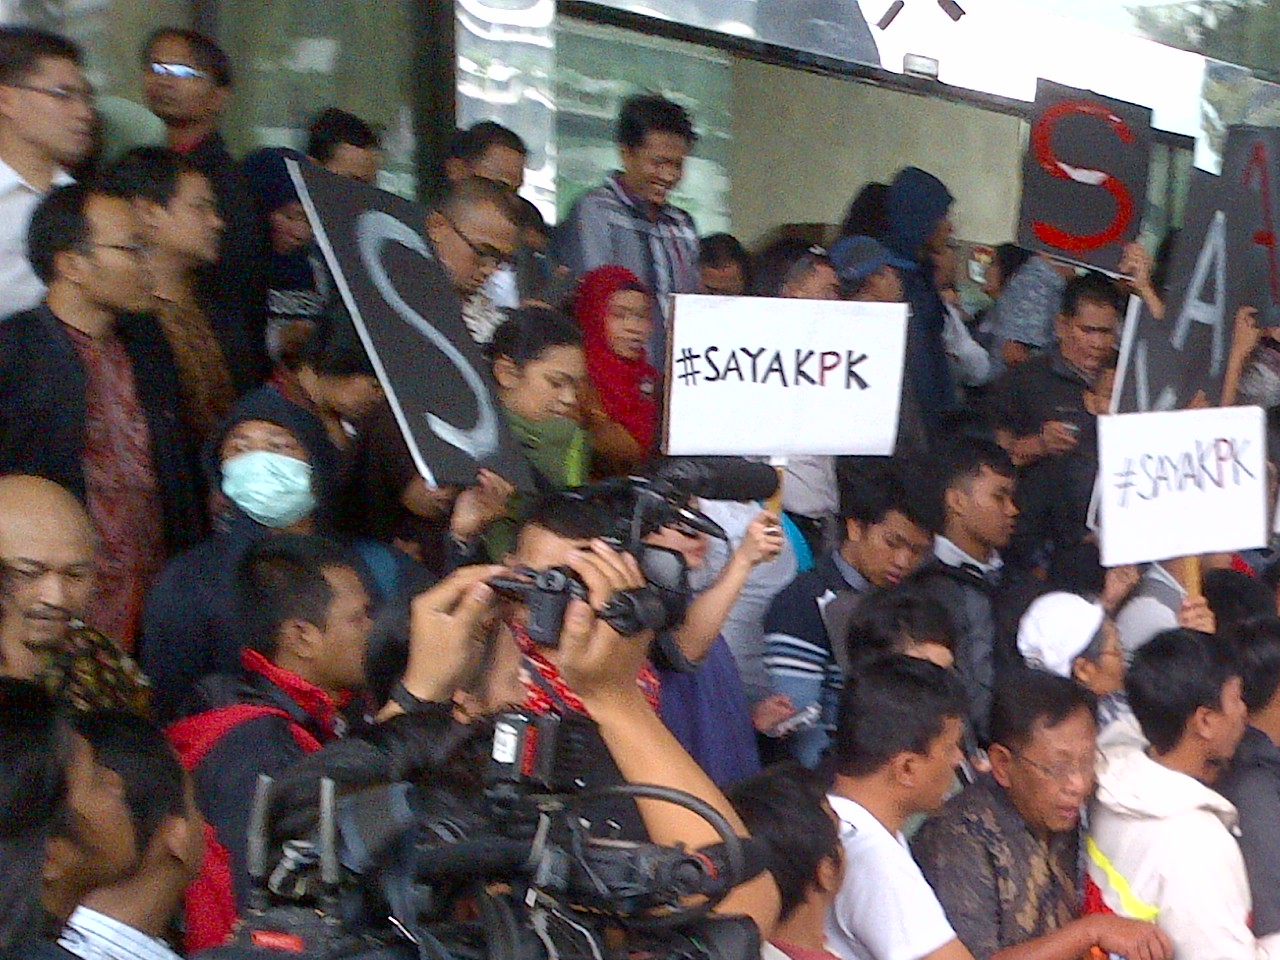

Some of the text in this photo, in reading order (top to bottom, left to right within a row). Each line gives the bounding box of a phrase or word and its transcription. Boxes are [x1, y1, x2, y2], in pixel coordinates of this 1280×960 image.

[1031, 98, 1135, 257] S
[355, 209, 500, 459] S
[676, 345, 870, 390] #SAYAKPK
[1171, 209, 1227, 377] A
